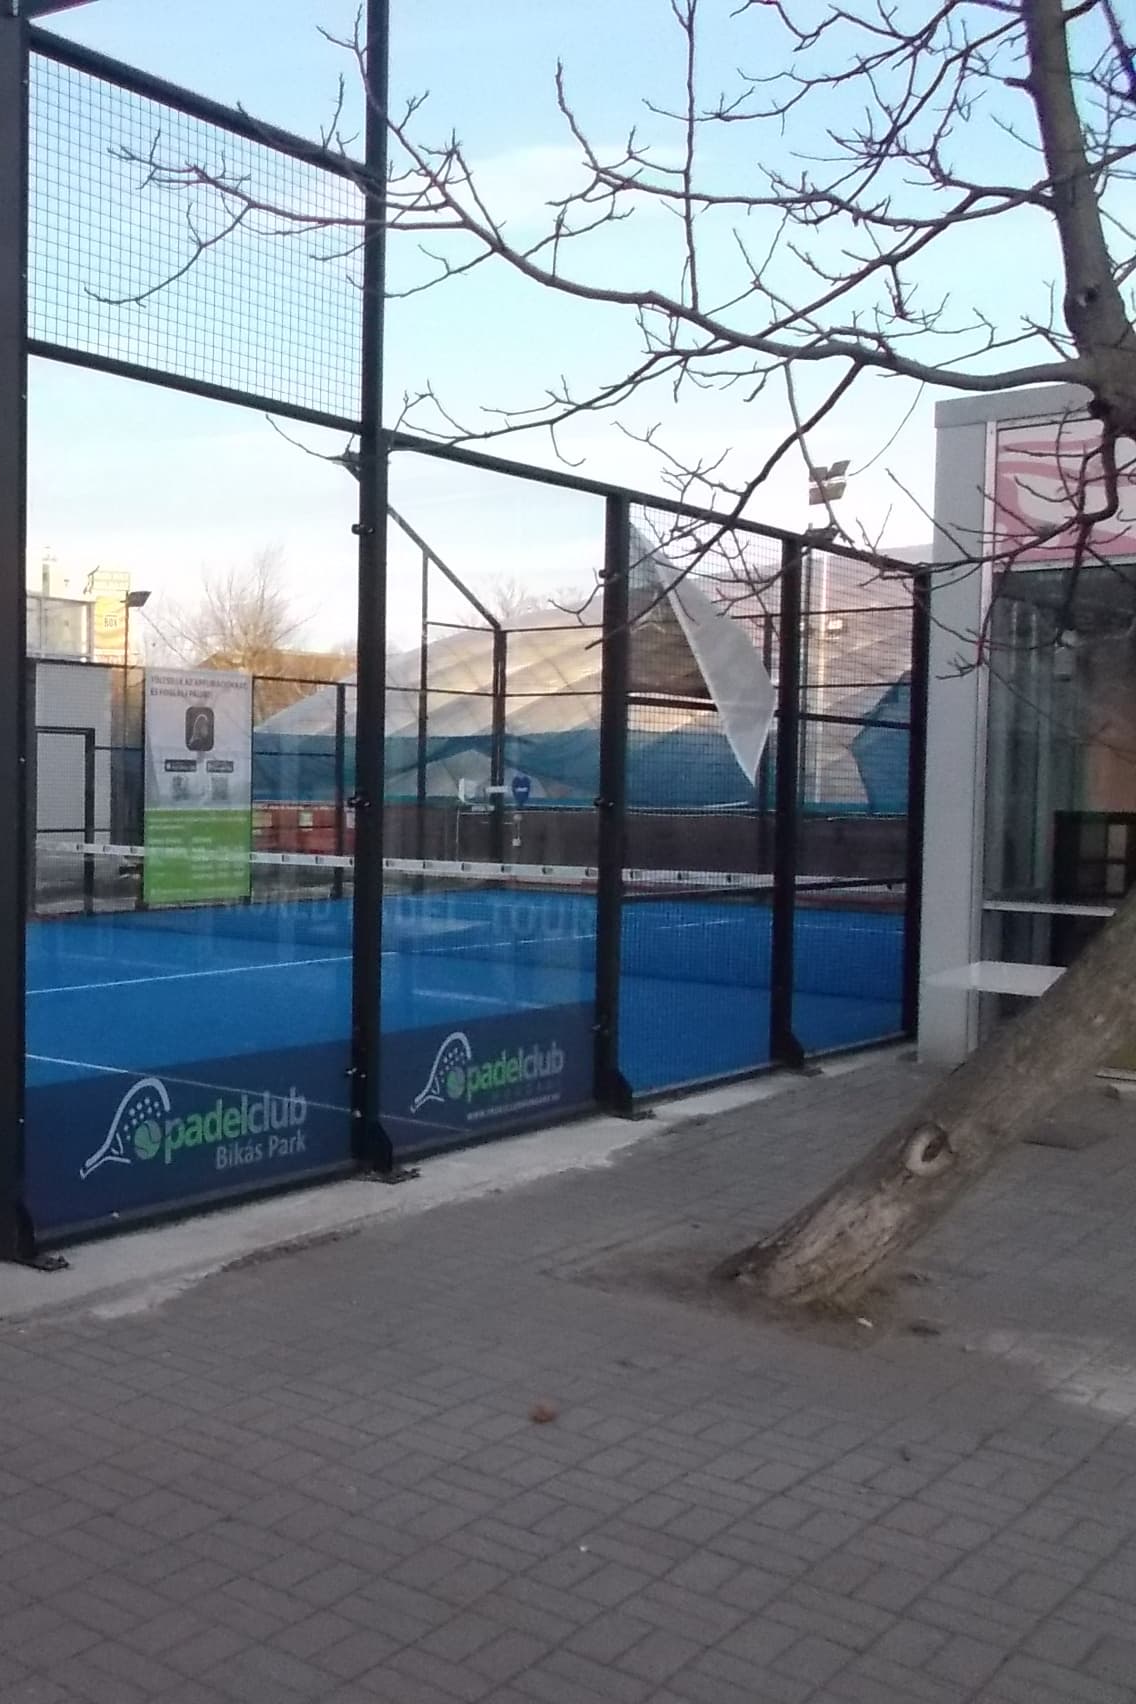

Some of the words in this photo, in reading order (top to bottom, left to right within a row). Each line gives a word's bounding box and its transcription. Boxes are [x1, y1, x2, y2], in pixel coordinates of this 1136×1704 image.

[467, 1041, 565, 1103] padelclub
[165, 1086, 307, 1164] padelclub
[215, 1138, 263, 1170] Bikás
[268, 1128, 306, 1158] Park
